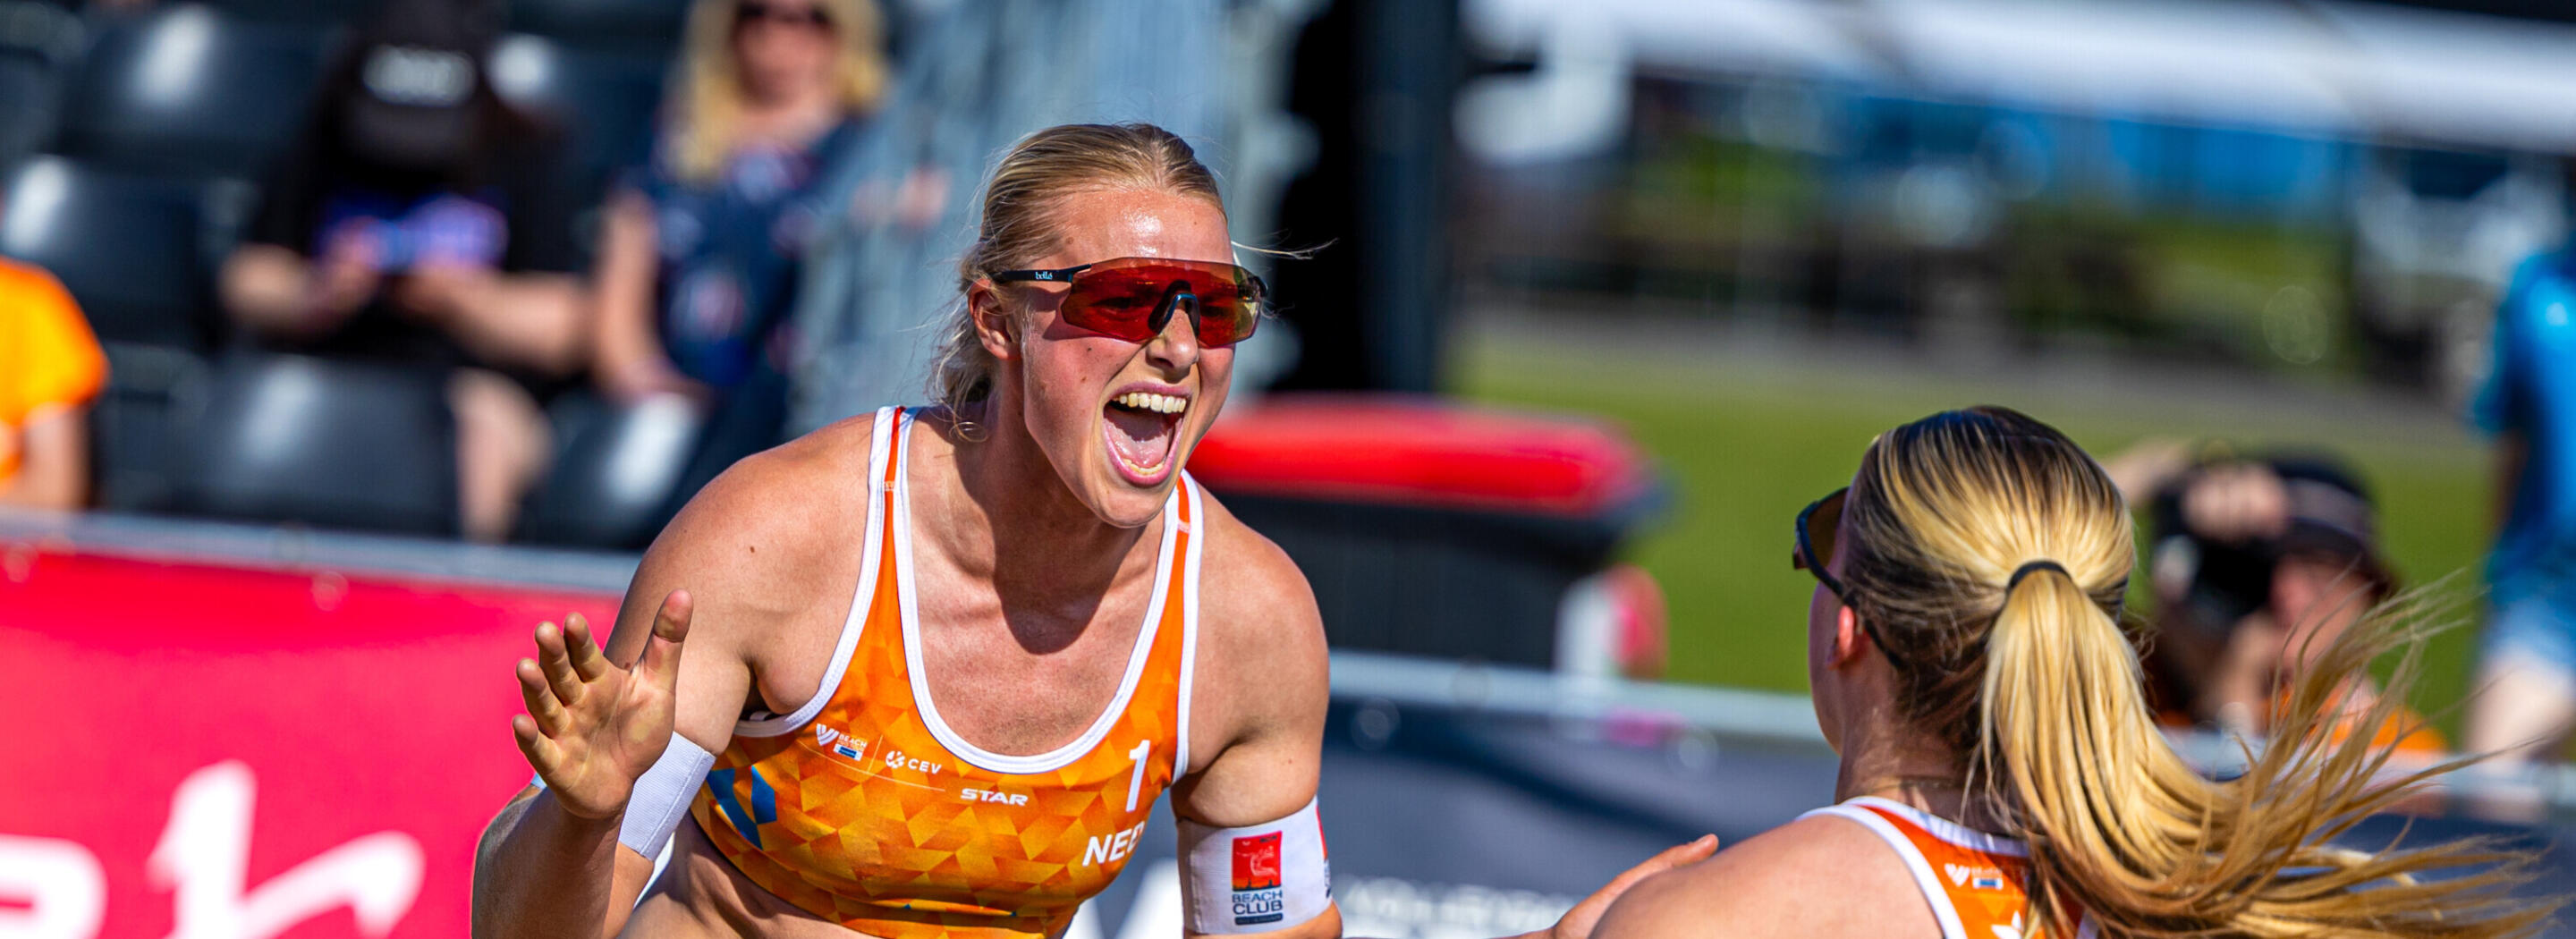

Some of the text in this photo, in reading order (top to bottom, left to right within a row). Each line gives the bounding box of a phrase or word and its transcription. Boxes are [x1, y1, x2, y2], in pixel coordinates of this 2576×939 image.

[907, 758, 943, 775] CEV
[1125, 740, 1150, 813] 1
[960, 788, 1029, 807] STAR
[1232, 890, 1284, 903] BEACH
[1233, 900, 1284, 916] CLUB
